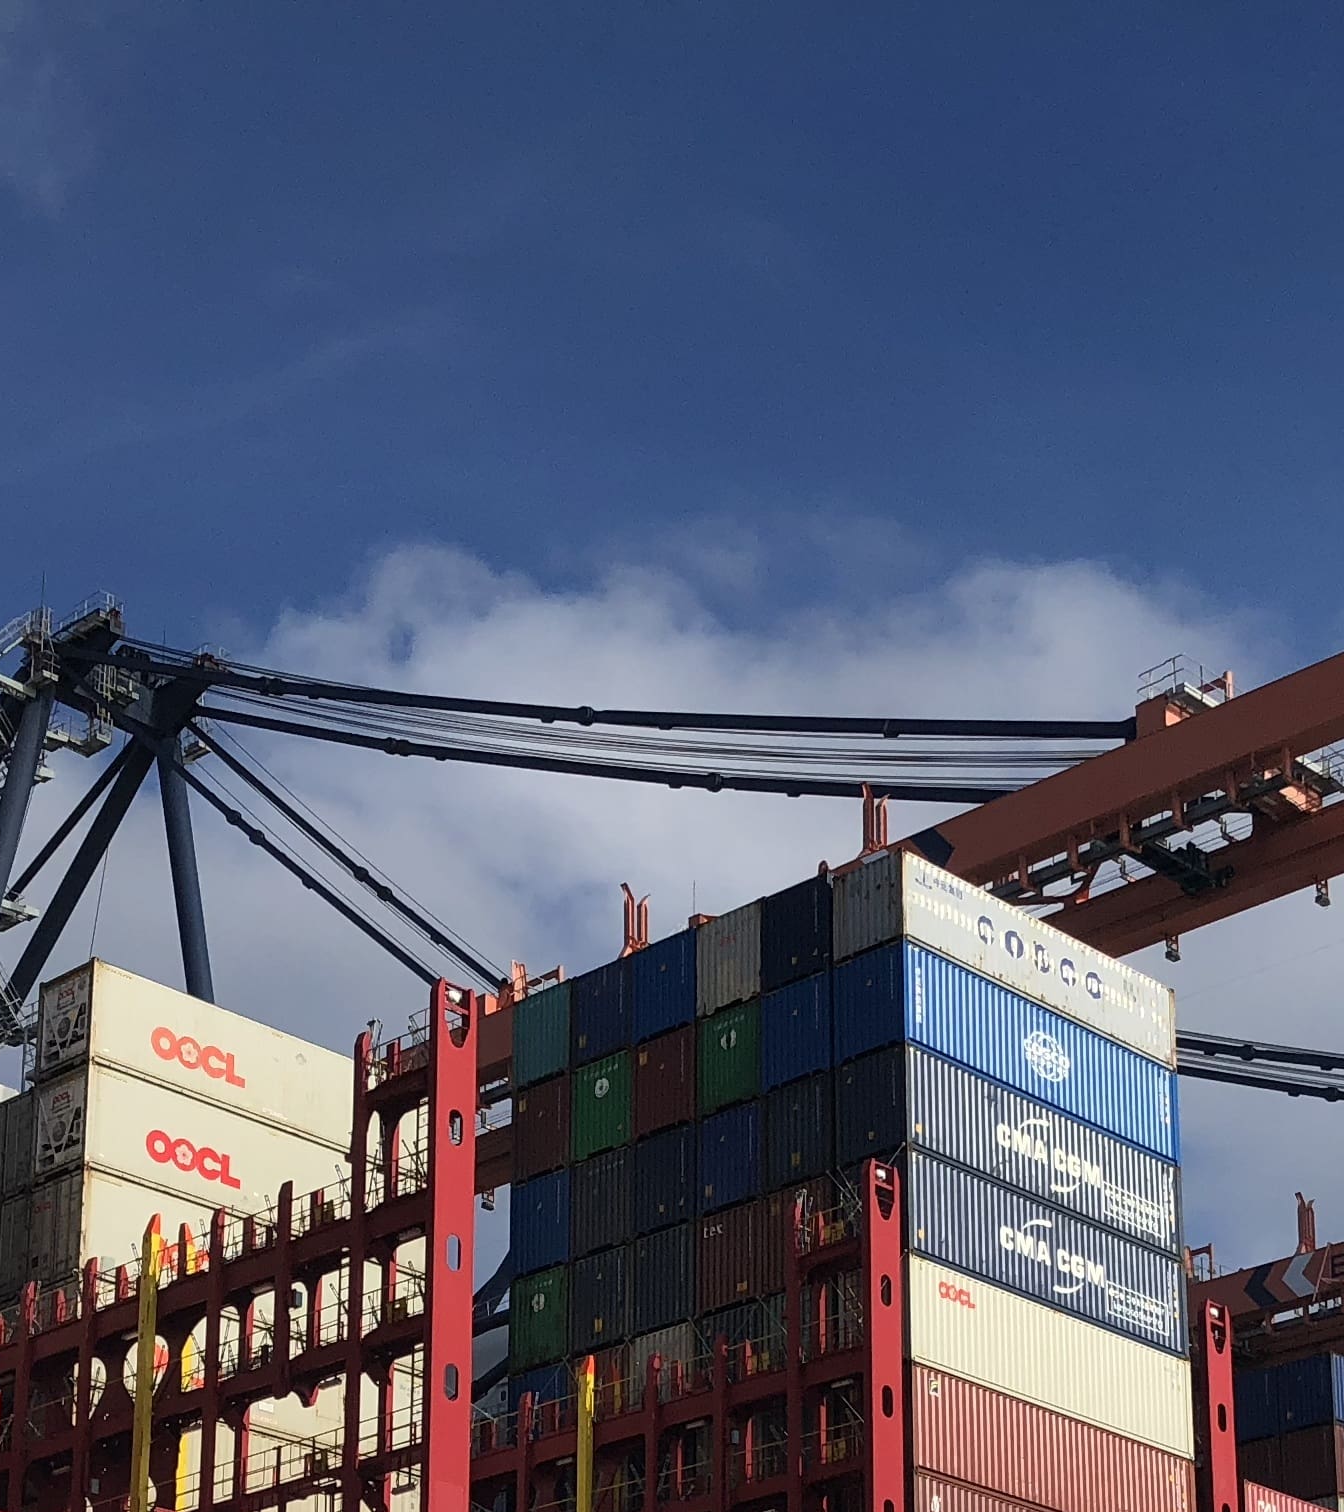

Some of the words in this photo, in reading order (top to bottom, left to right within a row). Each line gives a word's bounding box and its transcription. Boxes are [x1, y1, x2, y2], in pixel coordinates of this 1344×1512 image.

[977, 913, 1104, 1000] COSCO
[151, 1026, 245, 1088] OOCL
[146, 1129, 241, 1189] OOCL
[996, 1121, 1049, 1165] CMA
[1054, 1148, 1104, 1189] CGM
[999, 1225, 1052, 1267] CMA
[1057, 1249, 1106, 1289] CGM
[939, 1281, 976, 1309] OOCL
